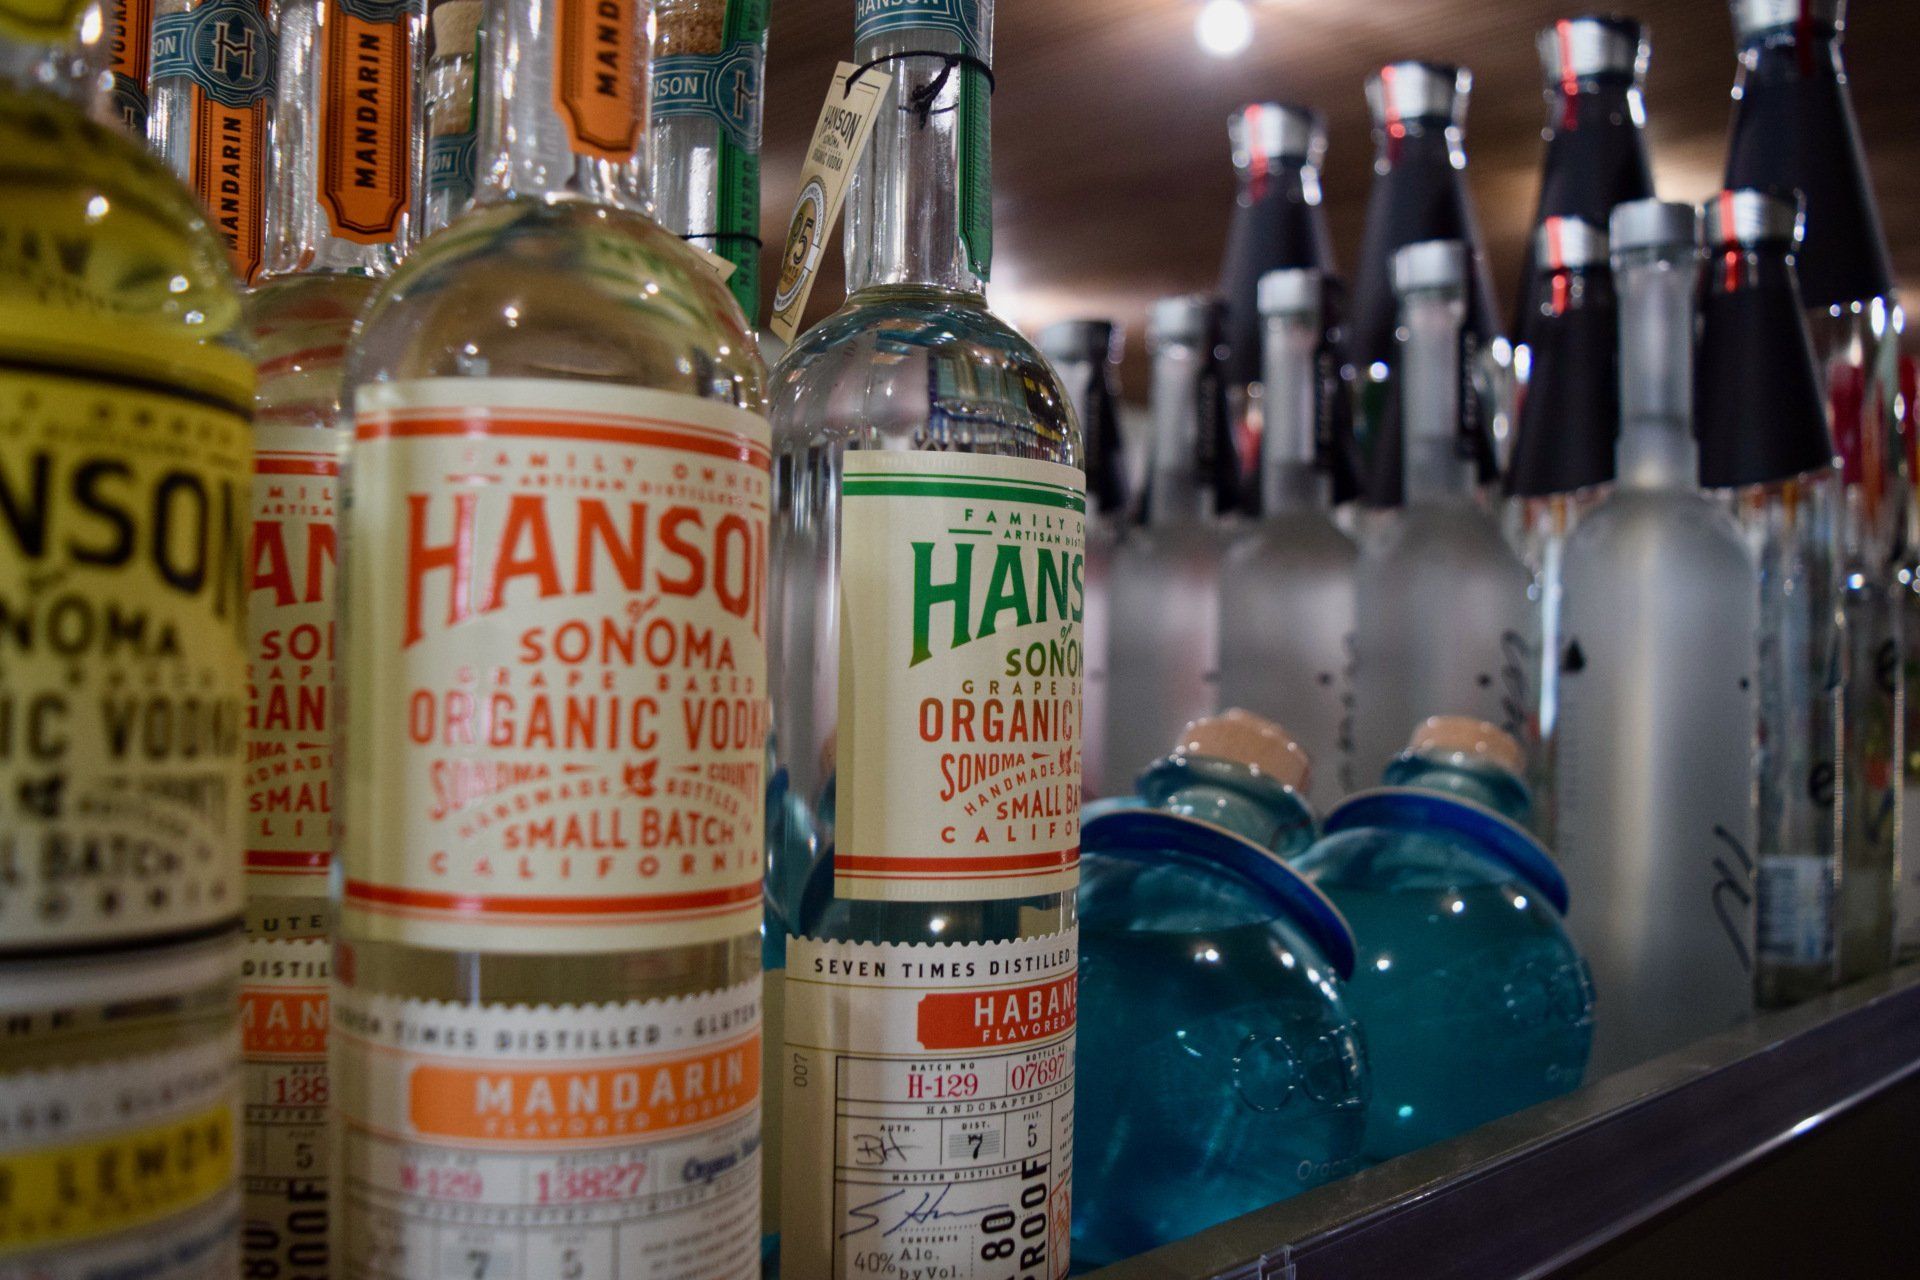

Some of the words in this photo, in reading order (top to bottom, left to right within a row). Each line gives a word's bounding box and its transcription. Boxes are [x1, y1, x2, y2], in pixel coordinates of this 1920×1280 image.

[355, 33, 380, 189] MANDARIN
[220, 116, 241, 251] MANDARIN
[965, 509, 1064, 530] FAMILY
[1004, 529, 1060, 543] ARTISAN
[518, 616, 737, 671] SONOMA
[458, 665, 615, 690] GRAPE
[962, 679, 1057, 696] GRAPE
[408, 689, 660, 752] ORGANIC
[919, 697, 1073, 743] ORGANIC
[940, 753, 1026, 802] SONOMA
[964, 761, 1055, 816] HANDMADE
[996, 784, 1062, 820] SMALL
[503, 808, 628, 850] SMALL
[641, 809, 735, 849] BATCH
[429, 849, 760, 881] CALIFORNIA
[815, 957, 886, 978] SEVEN
[902, 962, 975, 978] TIMES
[990, 948, 1070, 975] DISTILLED
[495, 1024, 660, 1051] DISTILLED
[982, 1015, 1066, 1042] FLAVORED
[475, 1051, 746, 1116] MANDARIN
[907, 1073, 979, 1099] H-129
[1011, 1054, 1065, 1092] 07697
[926, 1092, 1044, 1115] HANDCRAFTED
[961, 1120, 991, 1130] DIST.
[967, 1133, 984, 1160] 7
[1027, 1124, 1038, 1149] 5
[892, 1172, 945, 1182] MASTER
[954, 1163, 1018, 1180] DISTILLER
[981, 1210, 1016, 1261] 80
[1020, 1159, 1048, 1280] ROOF
[853, 1251, 897, 1274] 40%
[900, 1247, 940, 1261] Alc.
